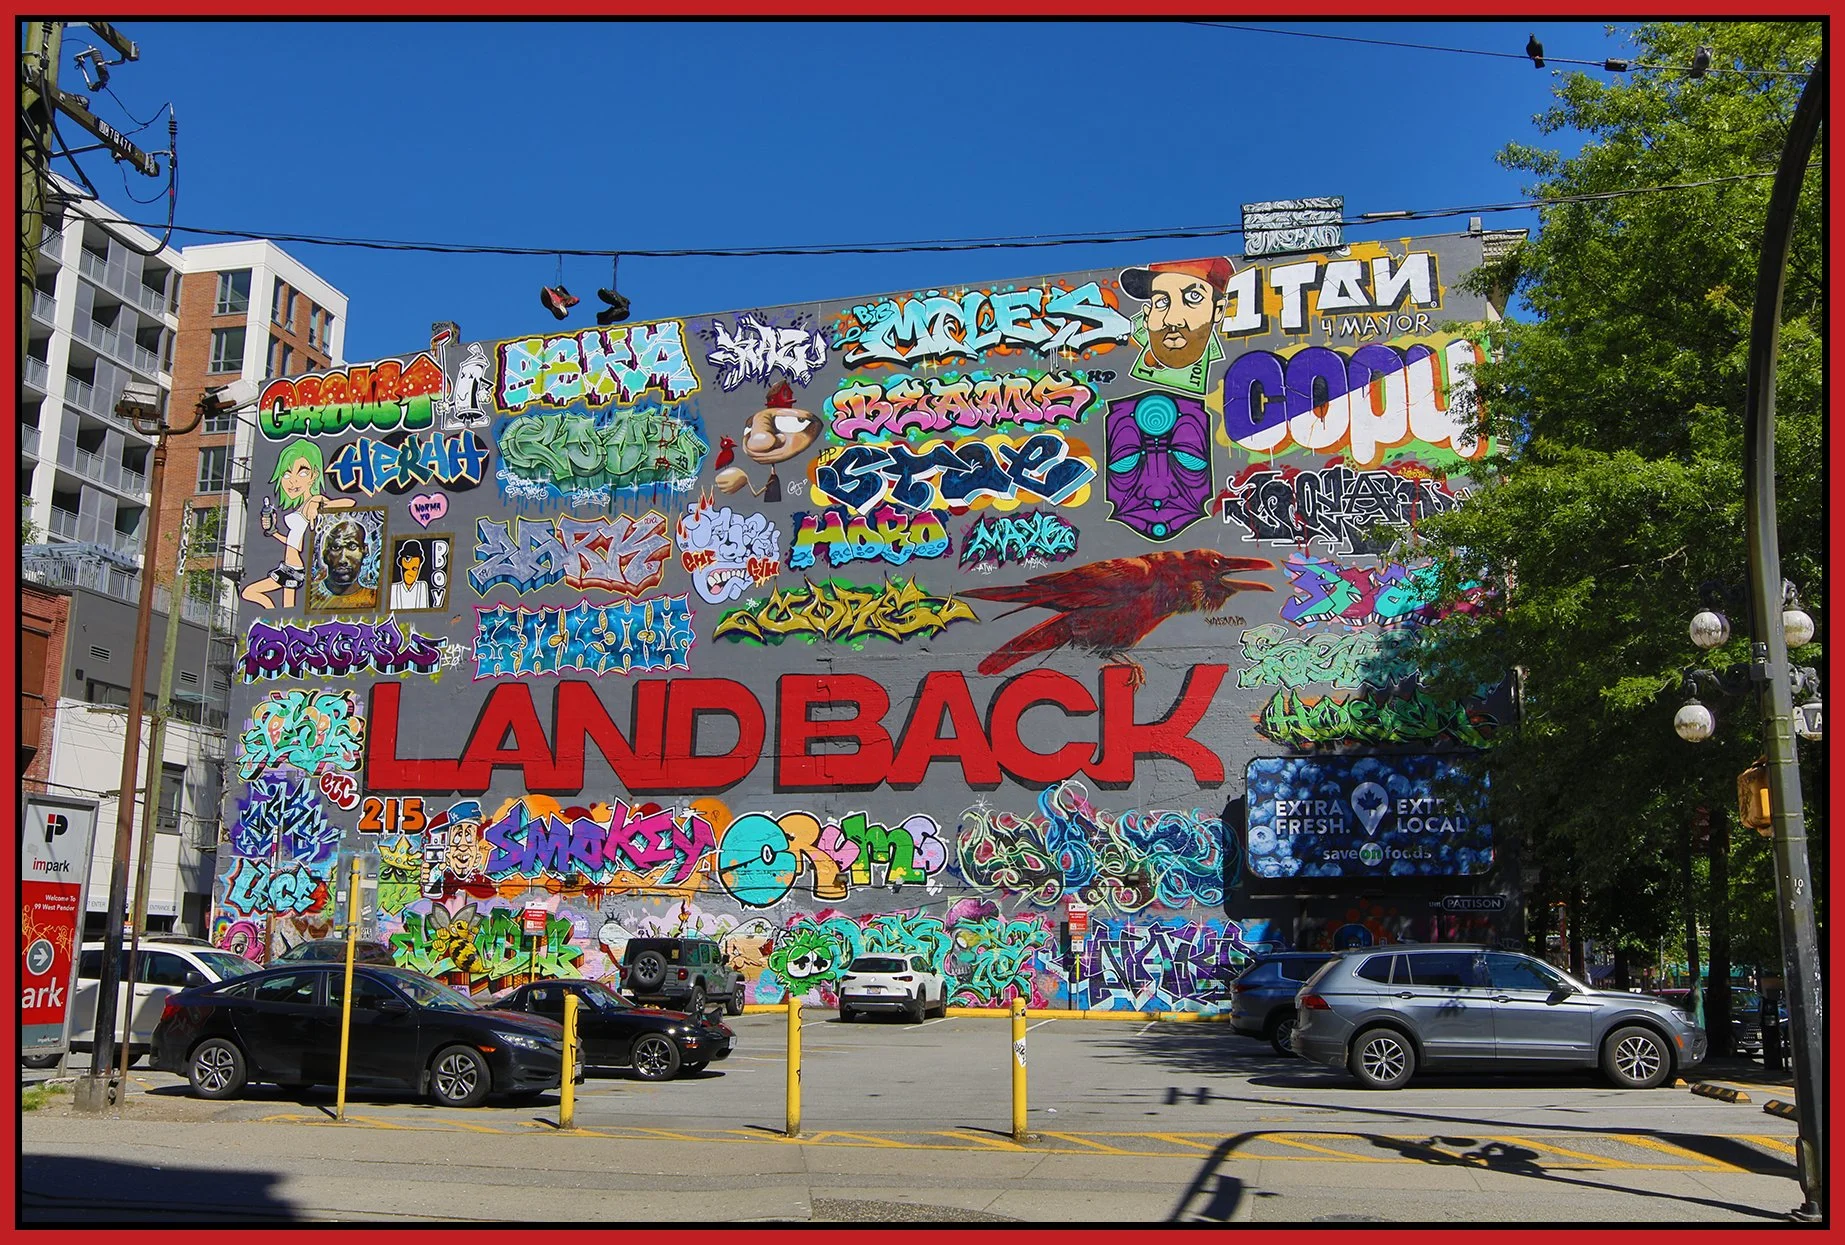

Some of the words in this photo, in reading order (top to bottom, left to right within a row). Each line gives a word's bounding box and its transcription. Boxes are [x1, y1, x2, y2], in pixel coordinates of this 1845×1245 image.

[1340, 313, 1434, 338] MAYOR
[414, 502, 441, 513] NORMA
[420, 512, 430, 521] XO
[431, 540, 450, 608] BOY
[366, 677, 767, 797] LAND
[774, 662, 1230, 794] BACK
[355, 795, 428, 837] 215
[1275, 800, 1344, 816] EXTRA
[1276, 818, 1351, 835] FRESH.
[485, 796, 716, 886] SMOKEY
[32, 857, 70, 874] impark
[1793, 878, 1804, 888] 10
[45, 894, 69, 902] Welcome
[1447, 899, 1501, 908] PATTISON
